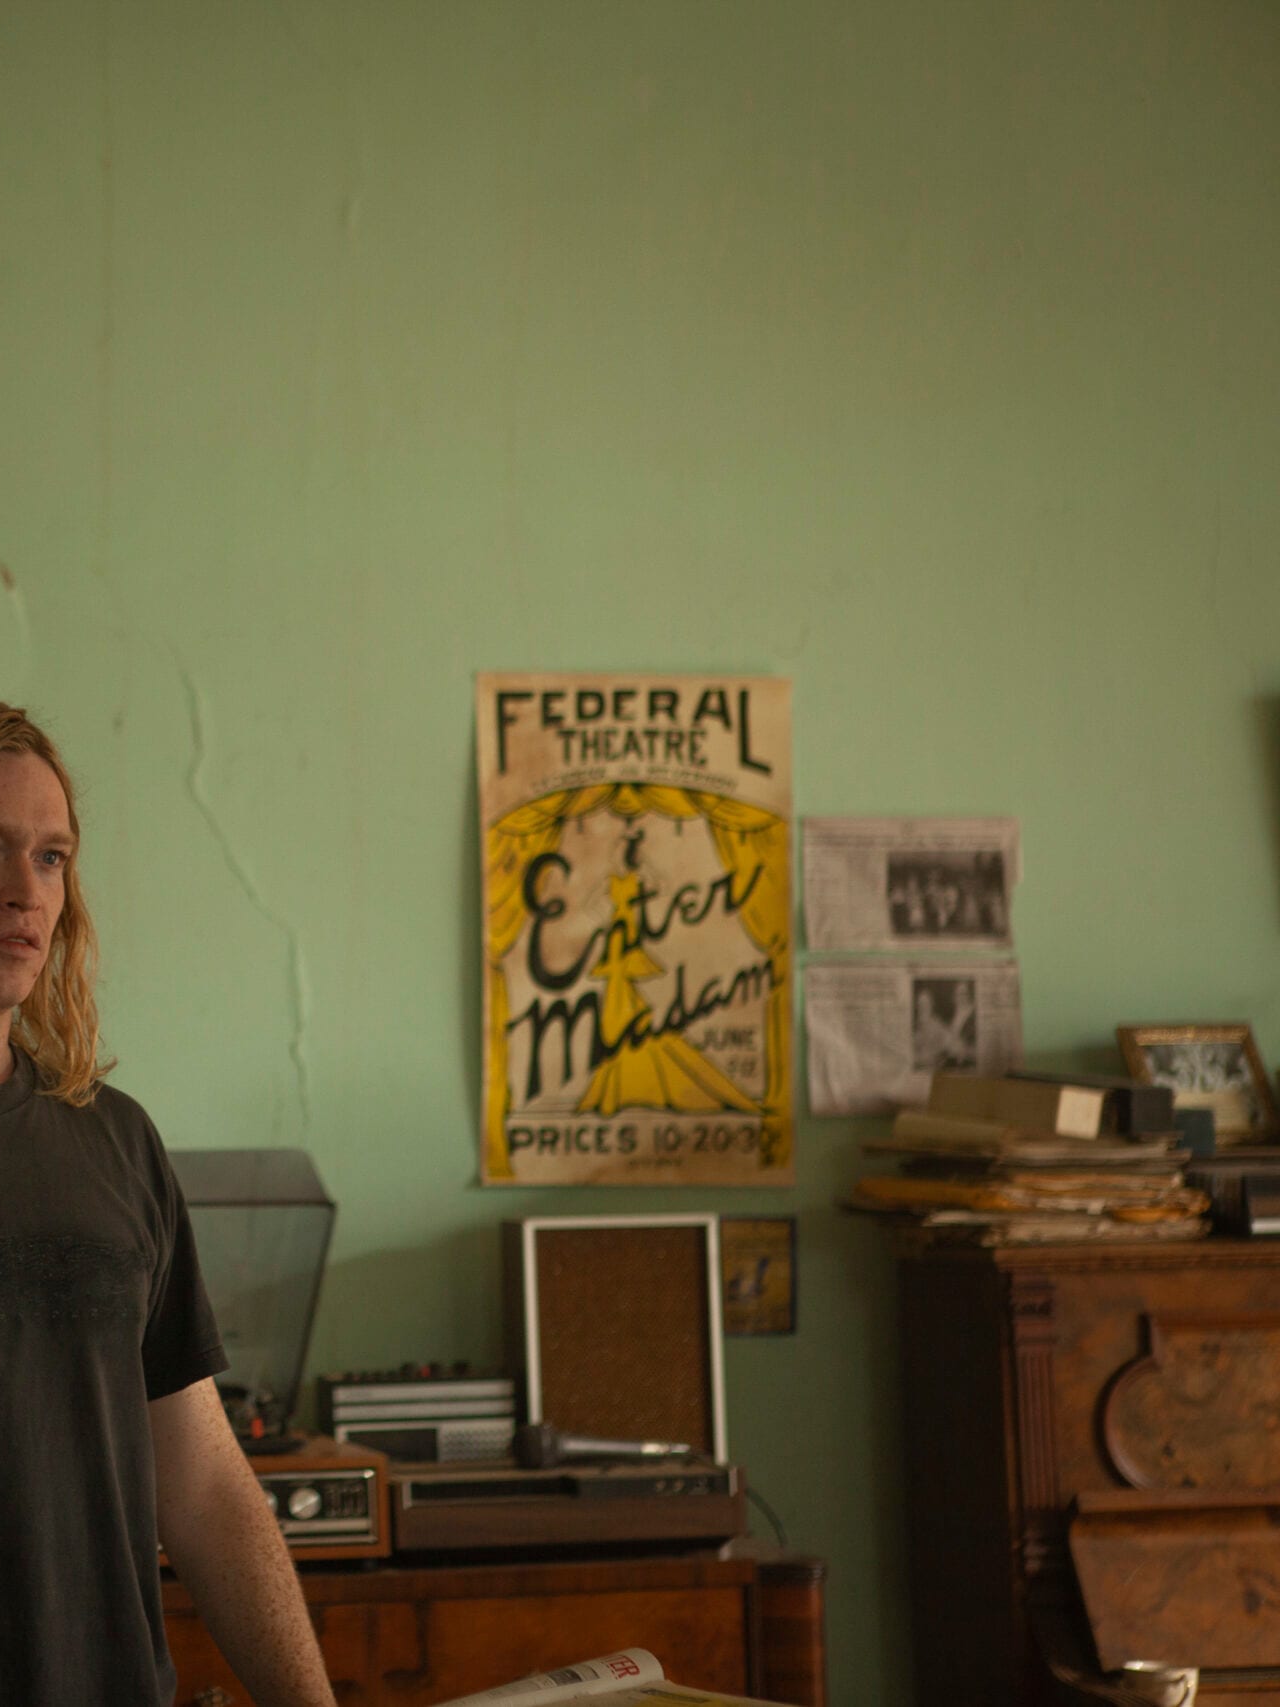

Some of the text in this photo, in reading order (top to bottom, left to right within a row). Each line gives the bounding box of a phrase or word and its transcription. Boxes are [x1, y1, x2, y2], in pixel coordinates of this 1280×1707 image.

[496, 687, 772, 778] FEDERAL
[556, 728, 708, 766] THEATRE
[523, 852, 763, 990] Enter
[506, 957, 785, 1100] Madam
[509, 1125, 638, 1154] PRICES
